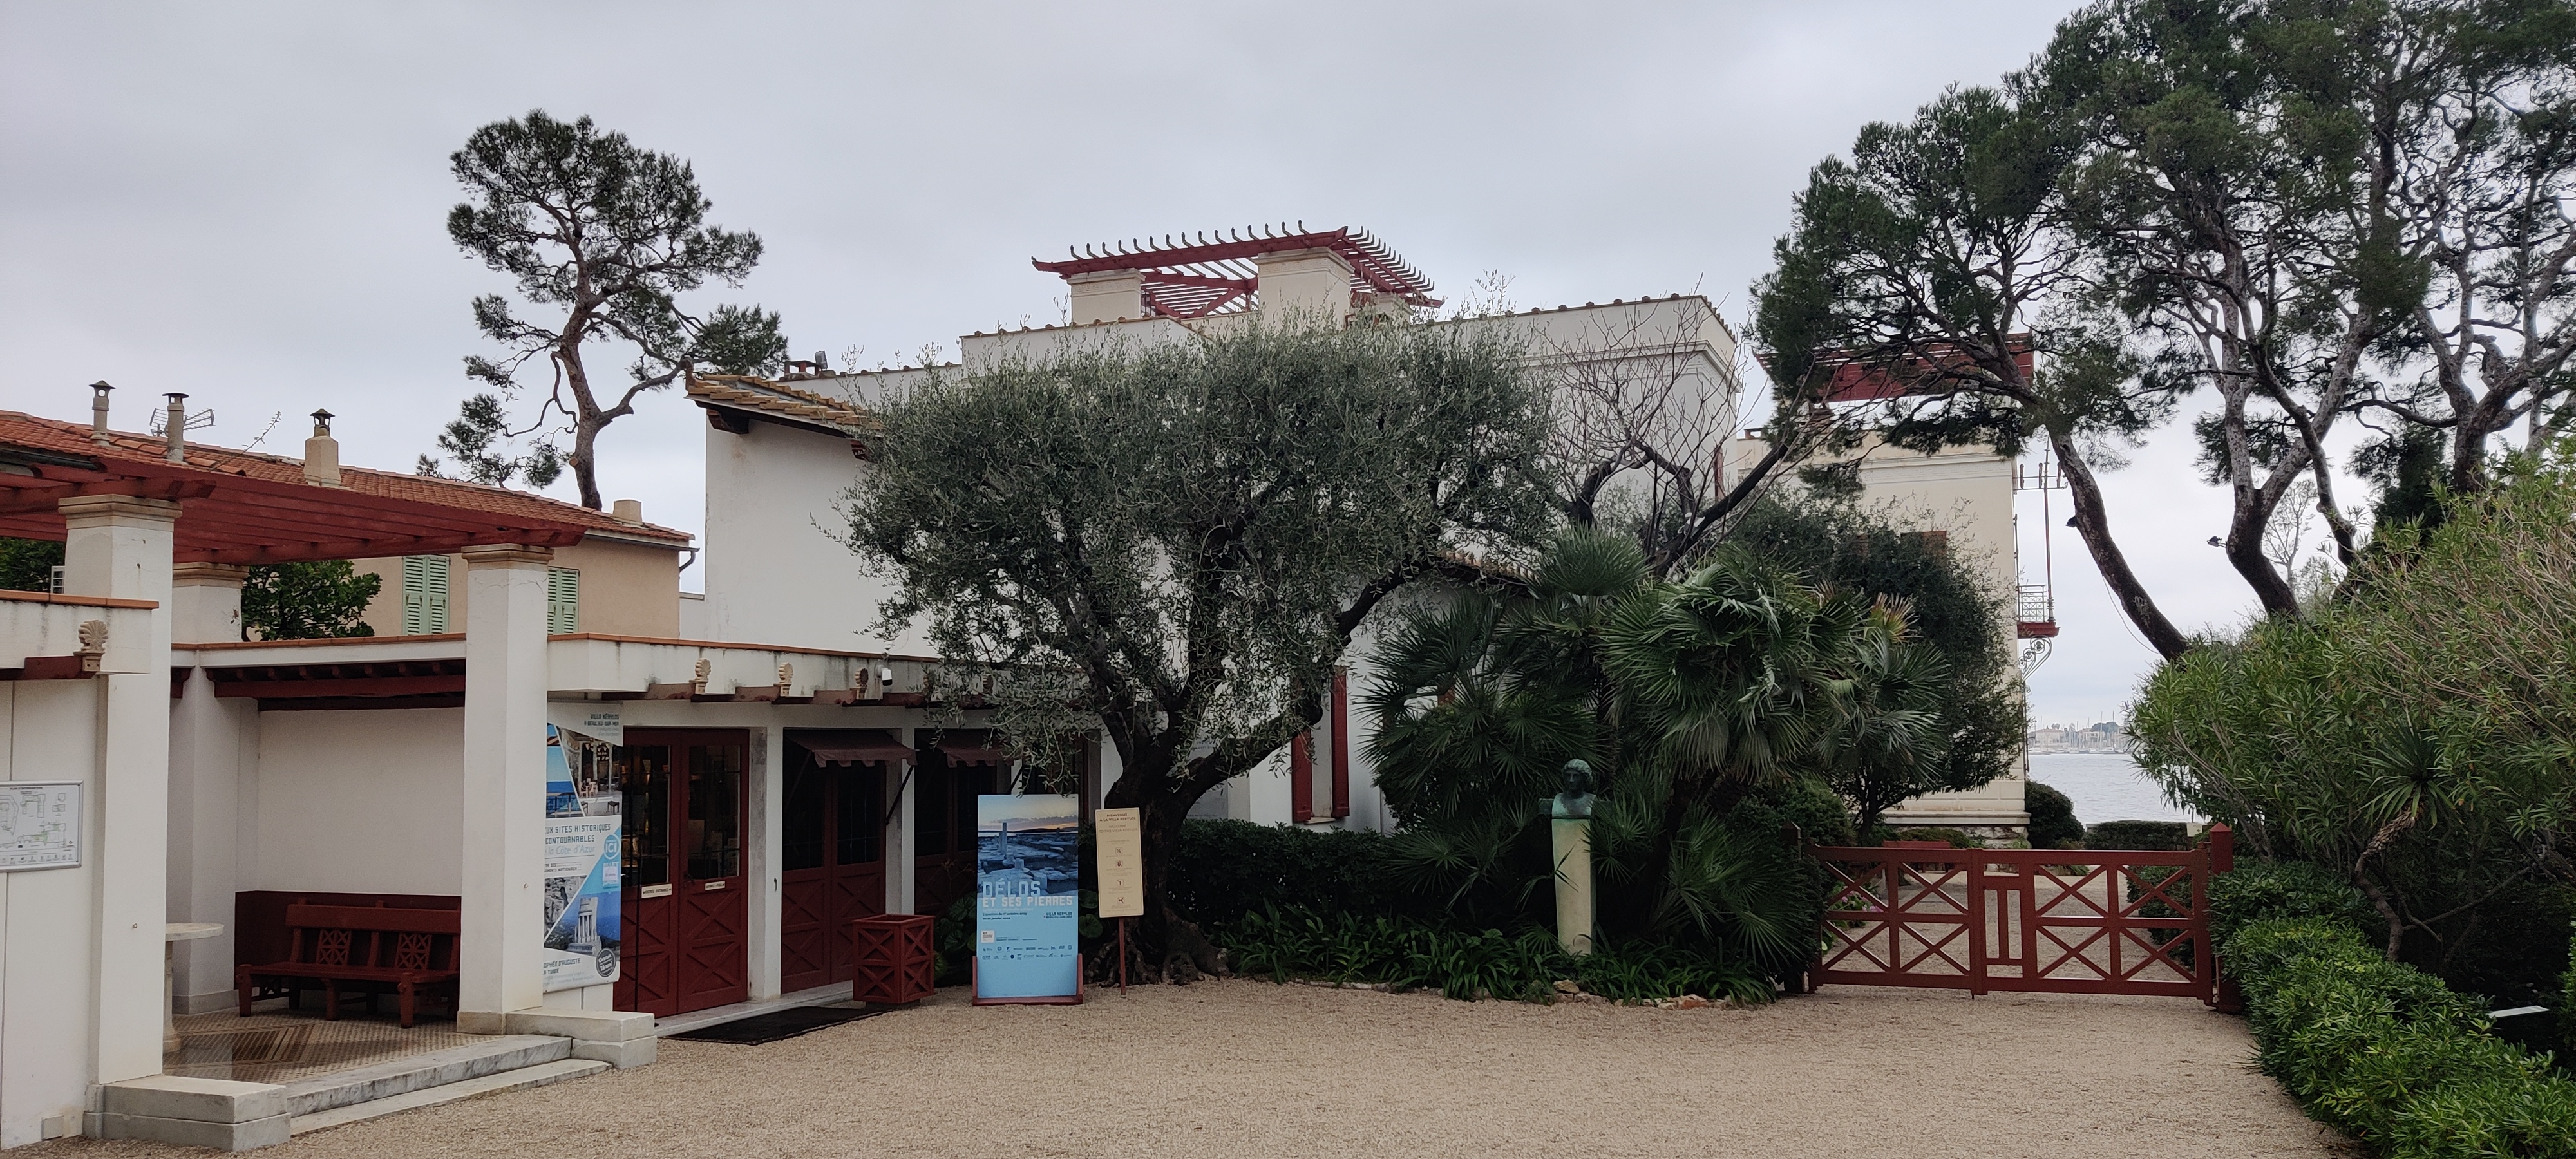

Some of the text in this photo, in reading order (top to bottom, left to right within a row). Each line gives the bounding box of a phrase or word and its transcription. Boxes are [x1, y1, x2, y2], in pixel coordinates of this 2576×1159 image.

[574, 824, 611, 833] HISTORIQUES
[545, 835, 595, 844] CONTOURNABLES
[548, 847, 554, 855] la
[556, 845, 571, 854] Côte
[605, 842, 617, 853] ICI
[983, 878, 1041, 897] DÉLOS
[983, 896, 1073, 907] ET SES PIERRES
